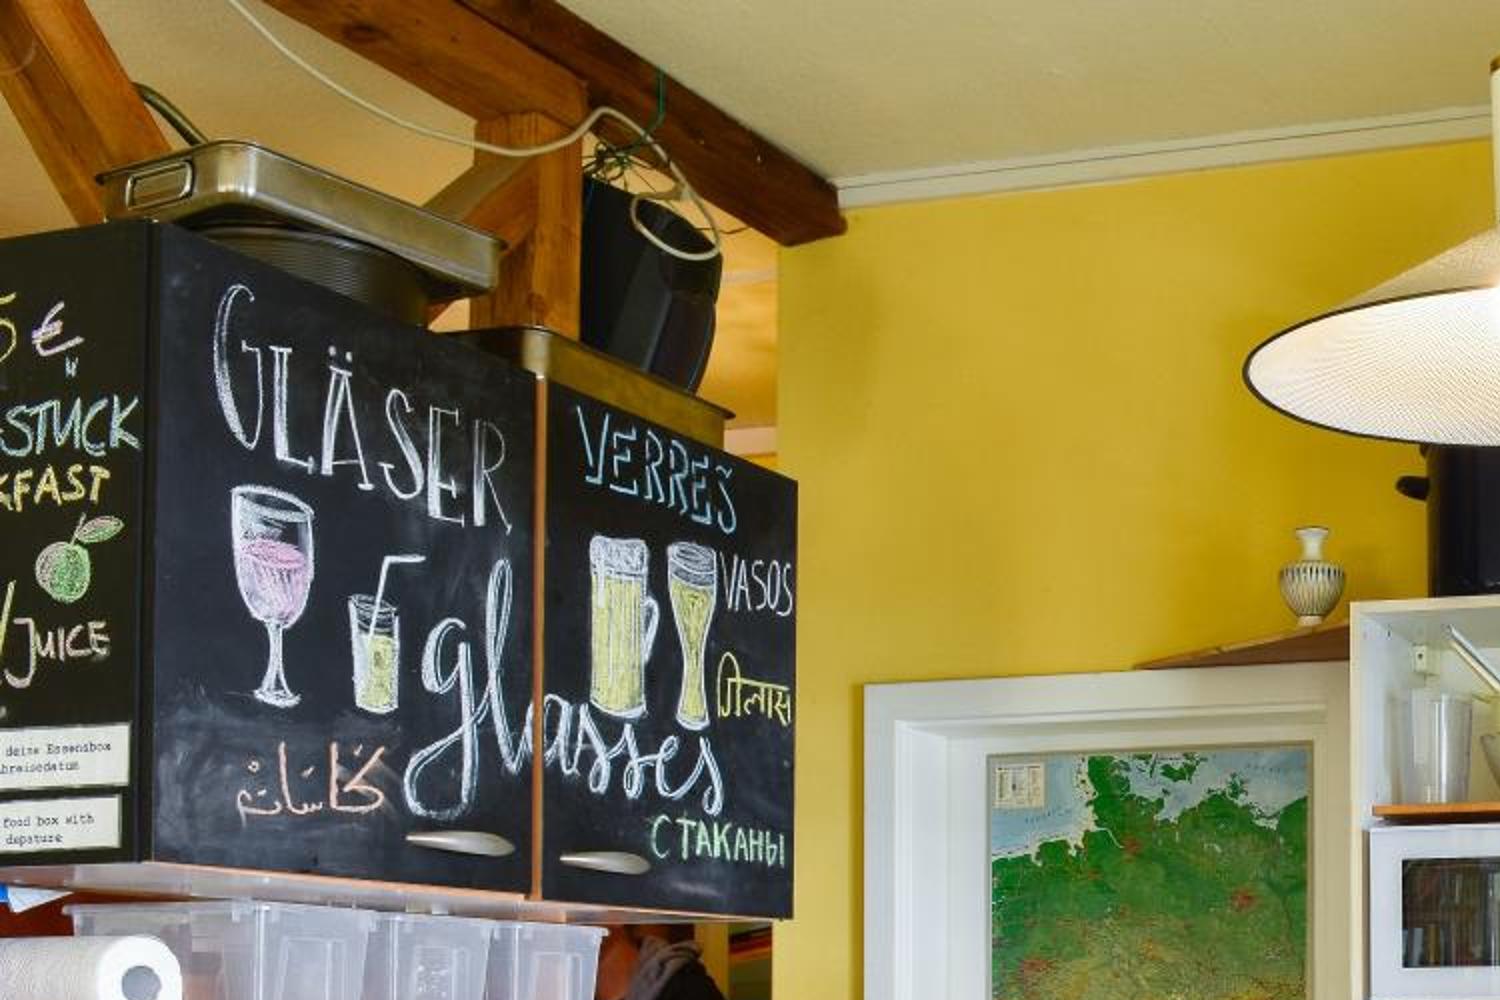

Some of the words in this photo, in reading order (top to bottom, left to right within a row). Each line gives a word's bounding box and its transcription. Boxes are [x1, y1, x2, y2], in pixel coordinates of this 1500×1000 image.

[213, 283, 512, 534] GLÄSER
[575, 404, 737, 534] VERRES
[719, 552, 793, 617] VASOS
[403, 557, 723, 820] glasses
[717, 651, 792, 727] गिलास
[37, 815, 59, 827] box
[650, 812, 787, 869] СТАКАНЫ
